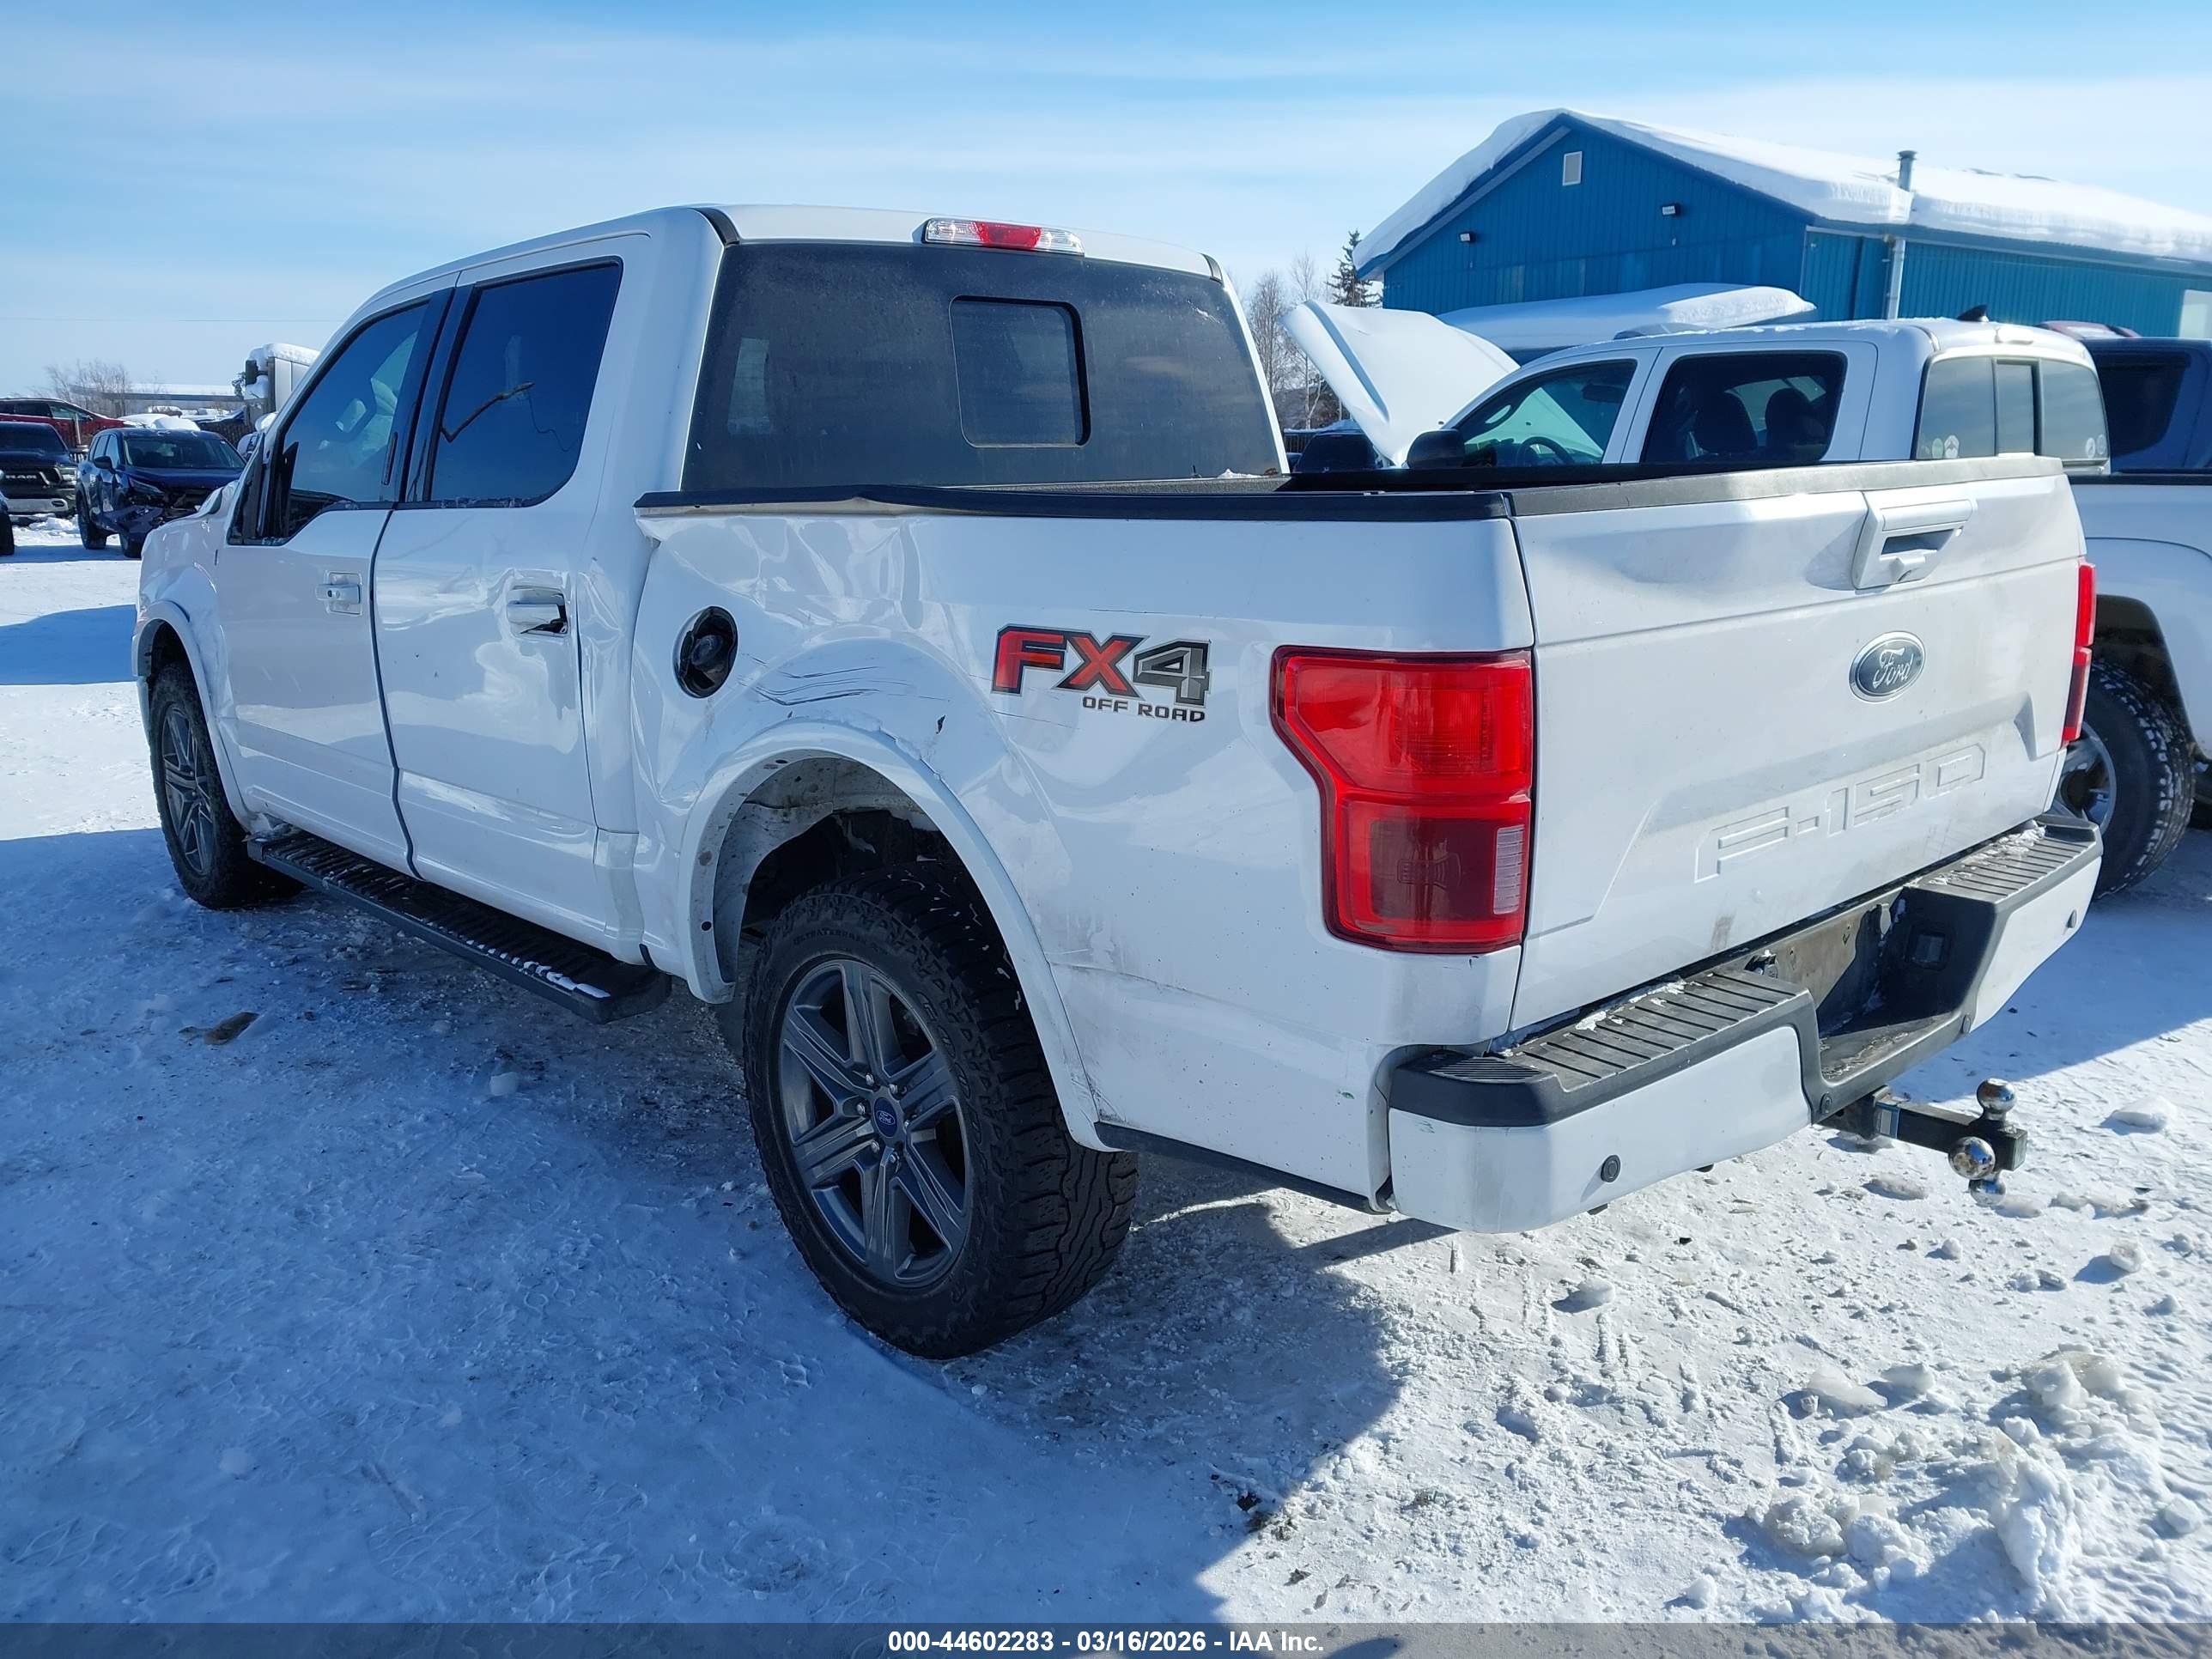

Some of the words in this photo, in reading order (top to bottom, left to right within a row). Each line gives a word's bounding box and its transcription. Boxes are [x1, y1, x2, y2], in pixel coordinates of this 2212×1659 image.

[991, 623, 1212, 708] FX4
[1872, 646, 1914, 689] Ford
[1082, 696, 1128, 713] OFF
[1138, 703, 1206, 723] ROAD
[1694, 742, 1986, 884] F-150
